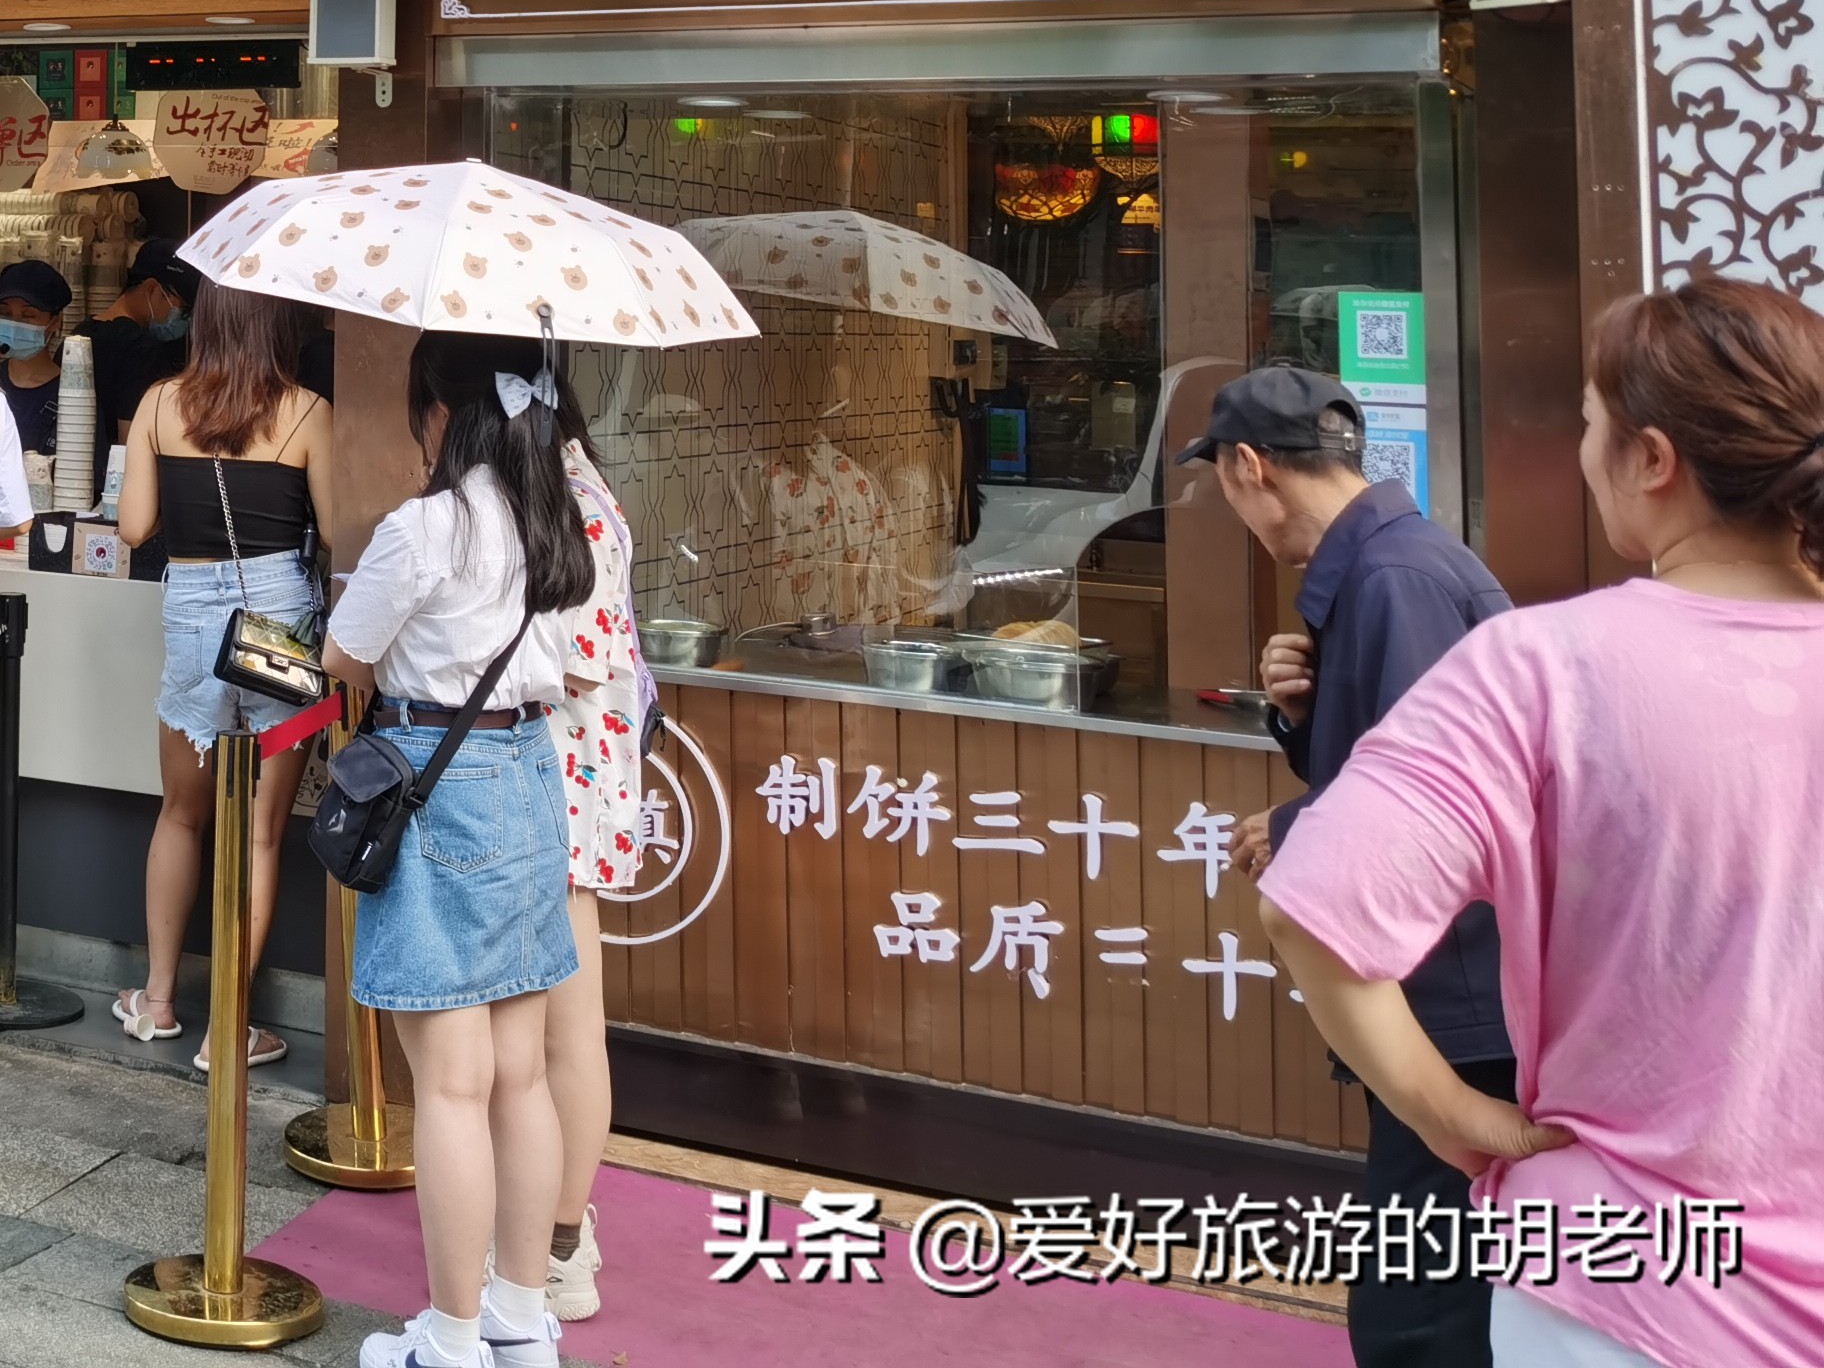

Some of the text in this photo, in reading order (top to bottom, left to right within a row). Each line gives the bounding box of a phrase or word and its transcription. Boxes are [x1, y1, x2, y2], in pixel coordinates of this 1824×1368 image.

[166, 96, 270, 146] 出杯区
[756, 754, 1236, 900] 制饼三十年
